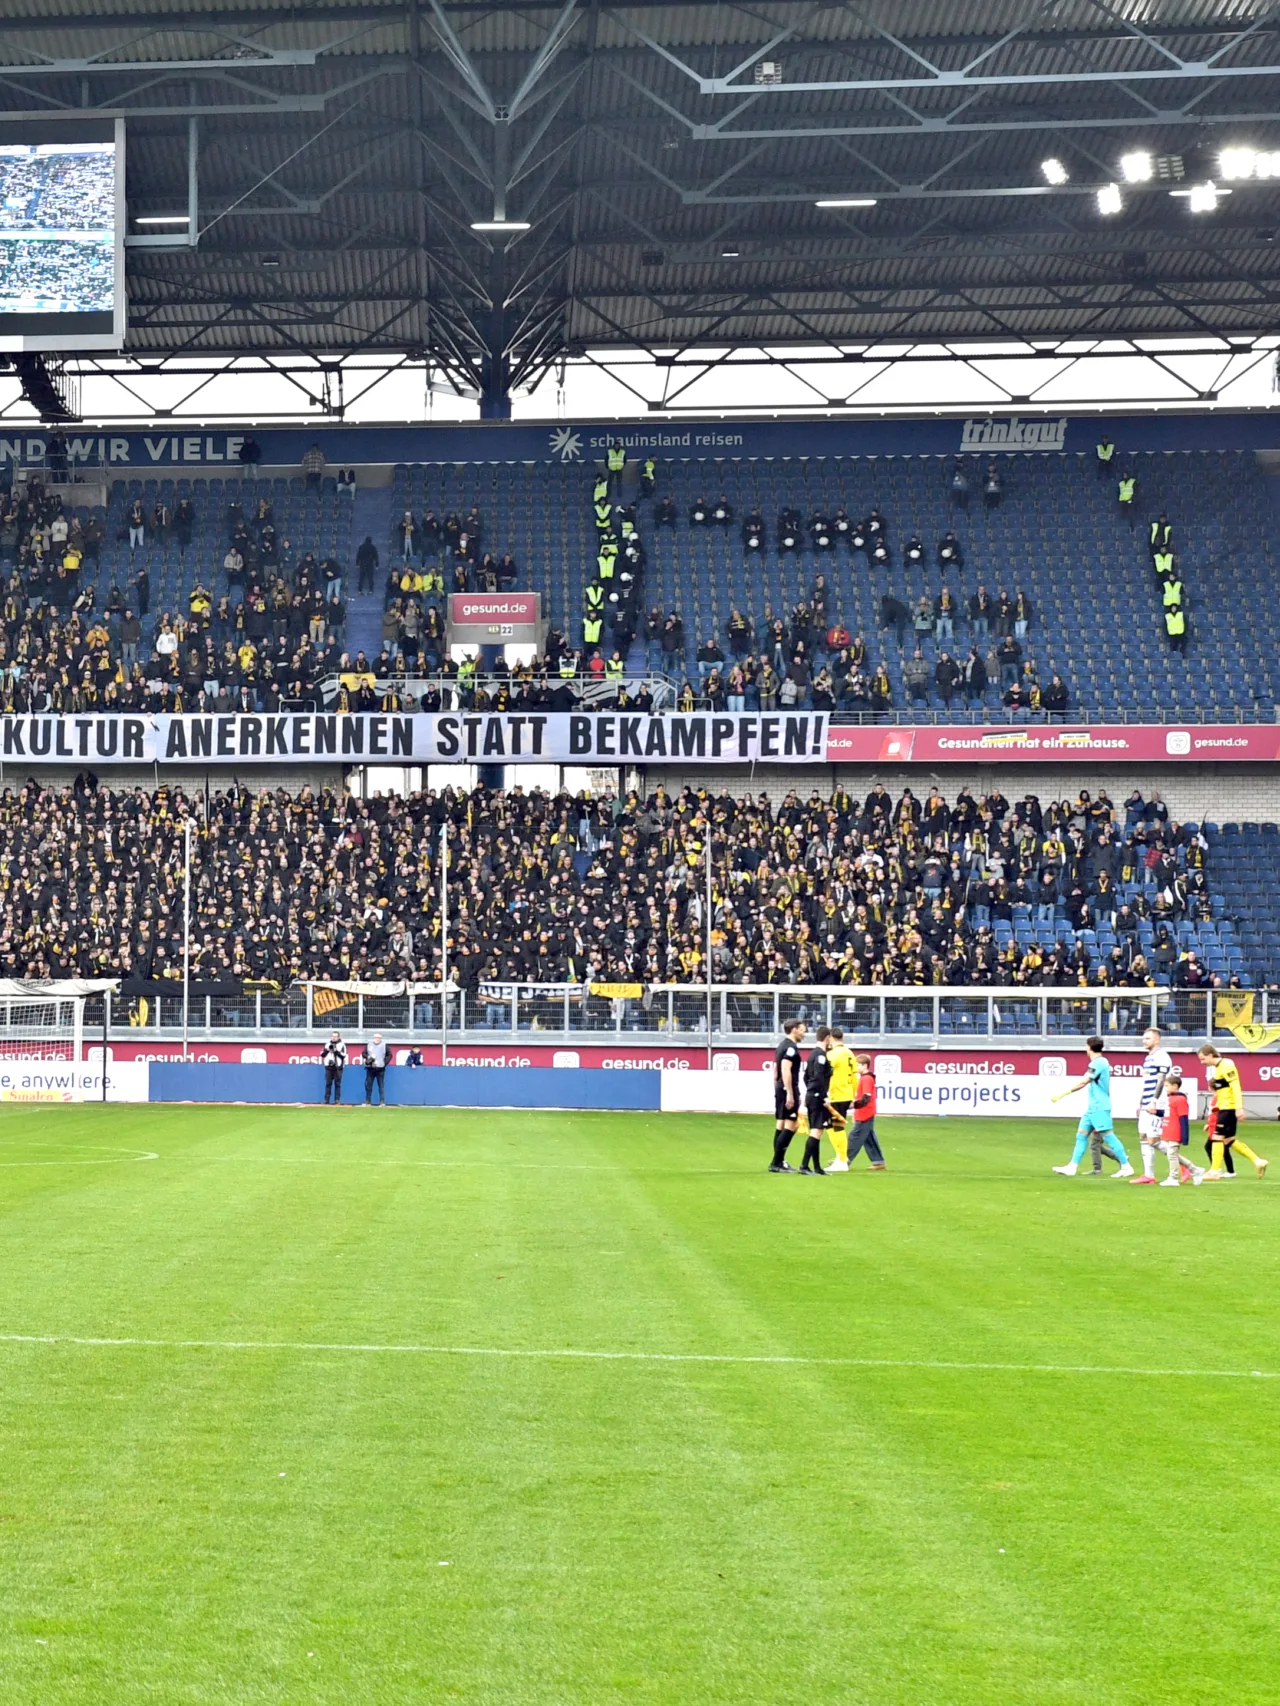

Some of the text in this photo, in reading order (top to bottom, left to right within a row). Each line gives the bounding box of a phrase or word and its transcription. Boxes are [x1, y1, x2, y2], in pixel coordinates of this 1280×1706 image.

[590, 432, 743, 448] schauinsland reisen
[961, 417, 1068, 450] trinkgut
[65, 437, 130, 462] WIR
[144, 436, 245, 461] VIELE
[463, 602, 527, 616] gesund.de
[502, 626, 512, 635] 22
[165, 716, 414, 757] ANERKENNEN
[436, 716, 548, 757] STATT
[1042, 736, 1064, 749] ein
[1194, 737, 1249, 749] gesund.de
[134, 1052, 220, 1063] gesundde
[924, 1060, 1016, 1075] gesund.de
[9, 1091, 54, 1102] Sinalco
[875, 1080, 1021, 1108] nique projects
